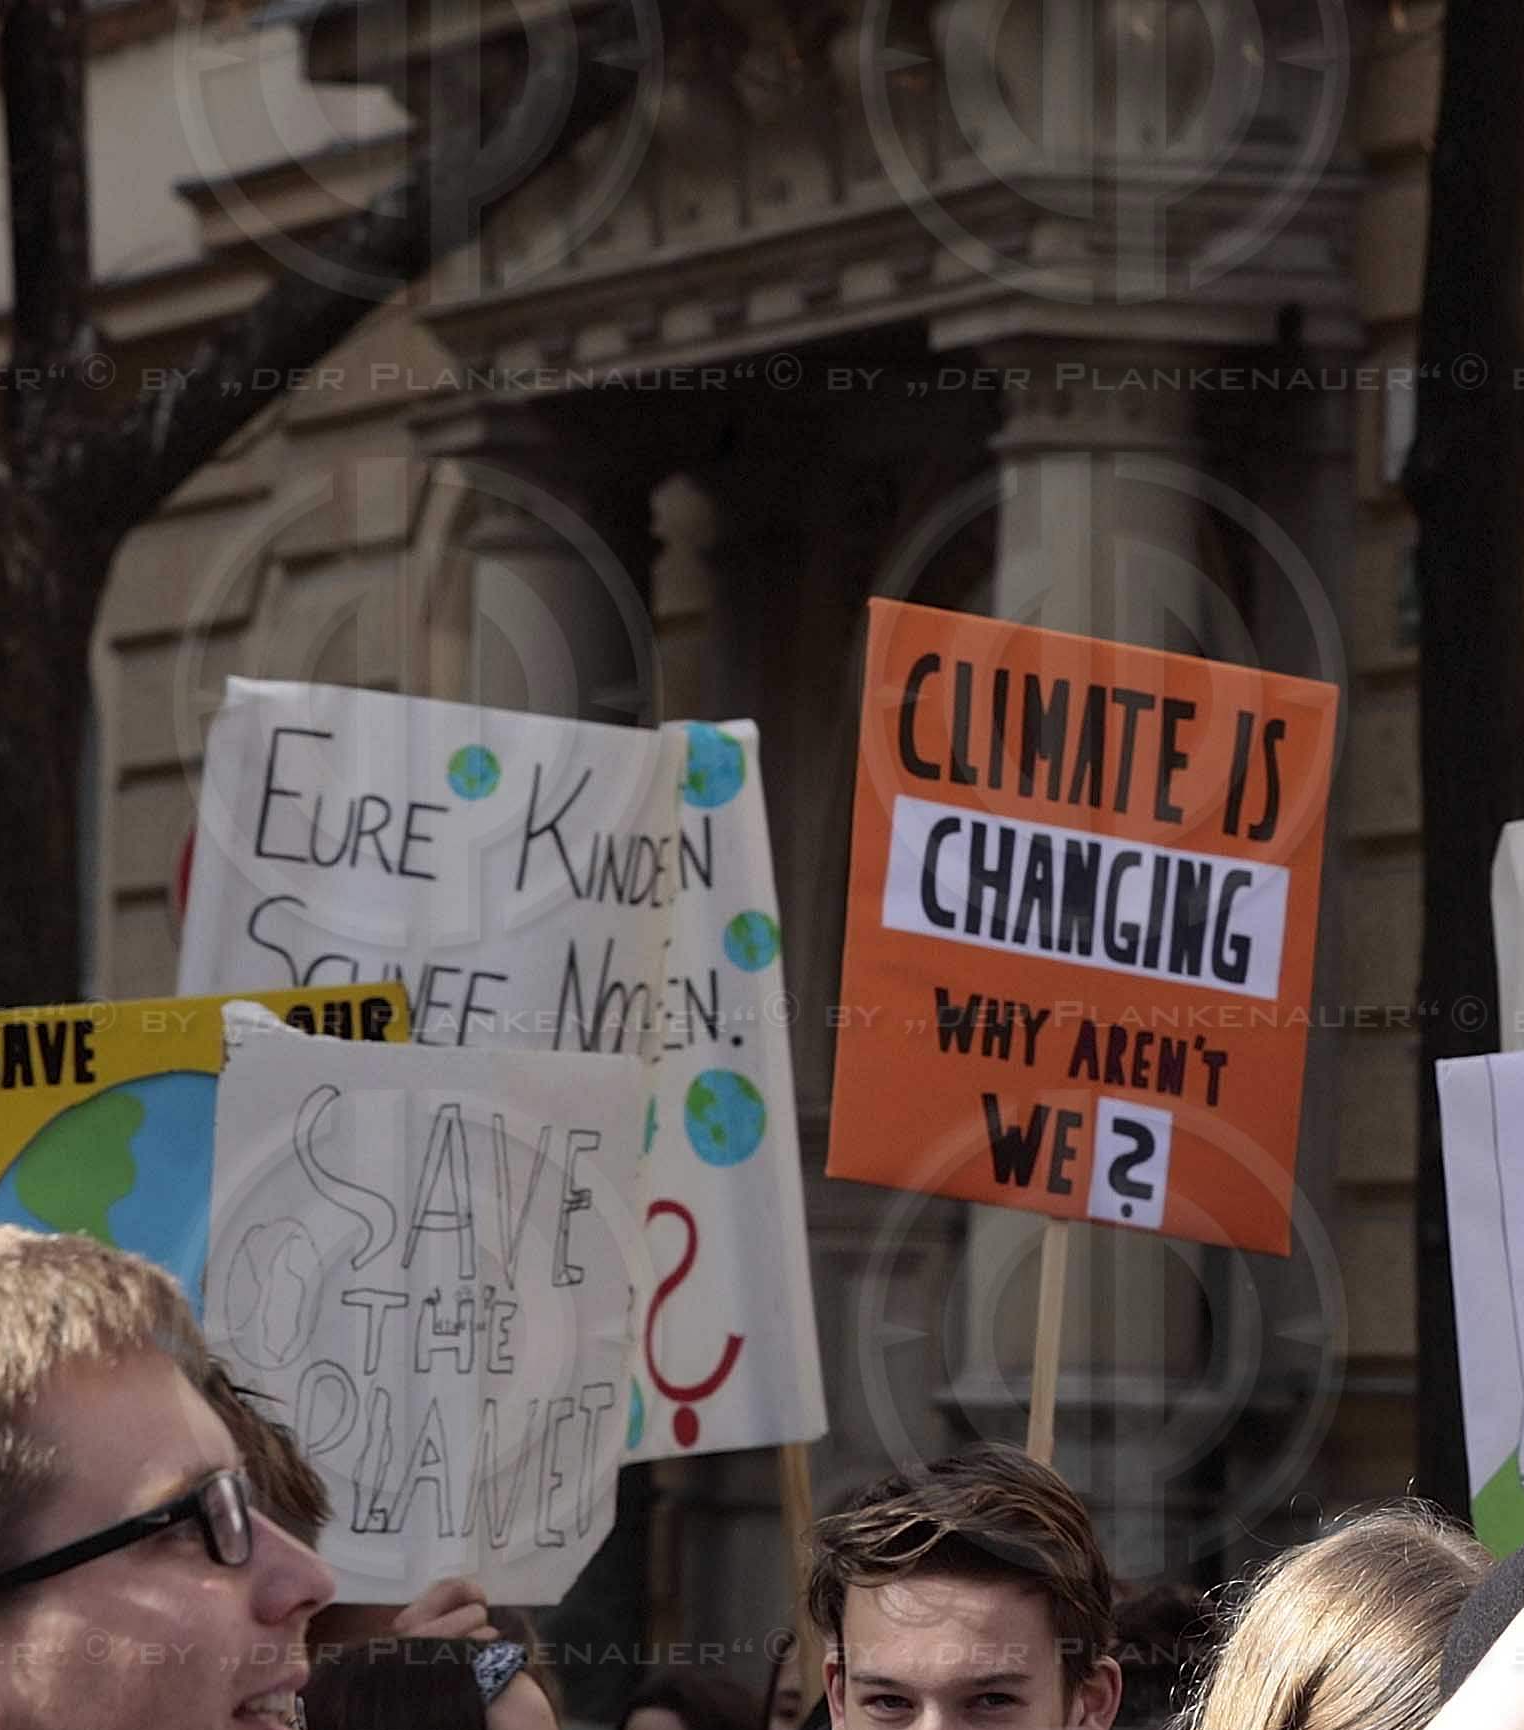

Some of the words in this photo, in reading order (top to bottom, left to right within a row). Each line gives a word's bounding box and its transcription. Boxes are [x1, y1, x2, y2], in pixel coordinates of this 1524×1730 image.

[254, 726, 448, 880] EURE
[898, 653, 1196, 824] CLIMATE
[1222, 709, 1287, 842] IS
[920, 817, 1252, 985] CHANGING
[934, 986, 1051, 1068] WHY
[1067, 1019, 1228, 1106] AREN'T
[292, 1083, 601, 1288] SAVE
[980, 1092, 1083, 1195] WE
[341, 1287, 519, 1376] THE
[293, 1358, 614, 1549] PLANET
